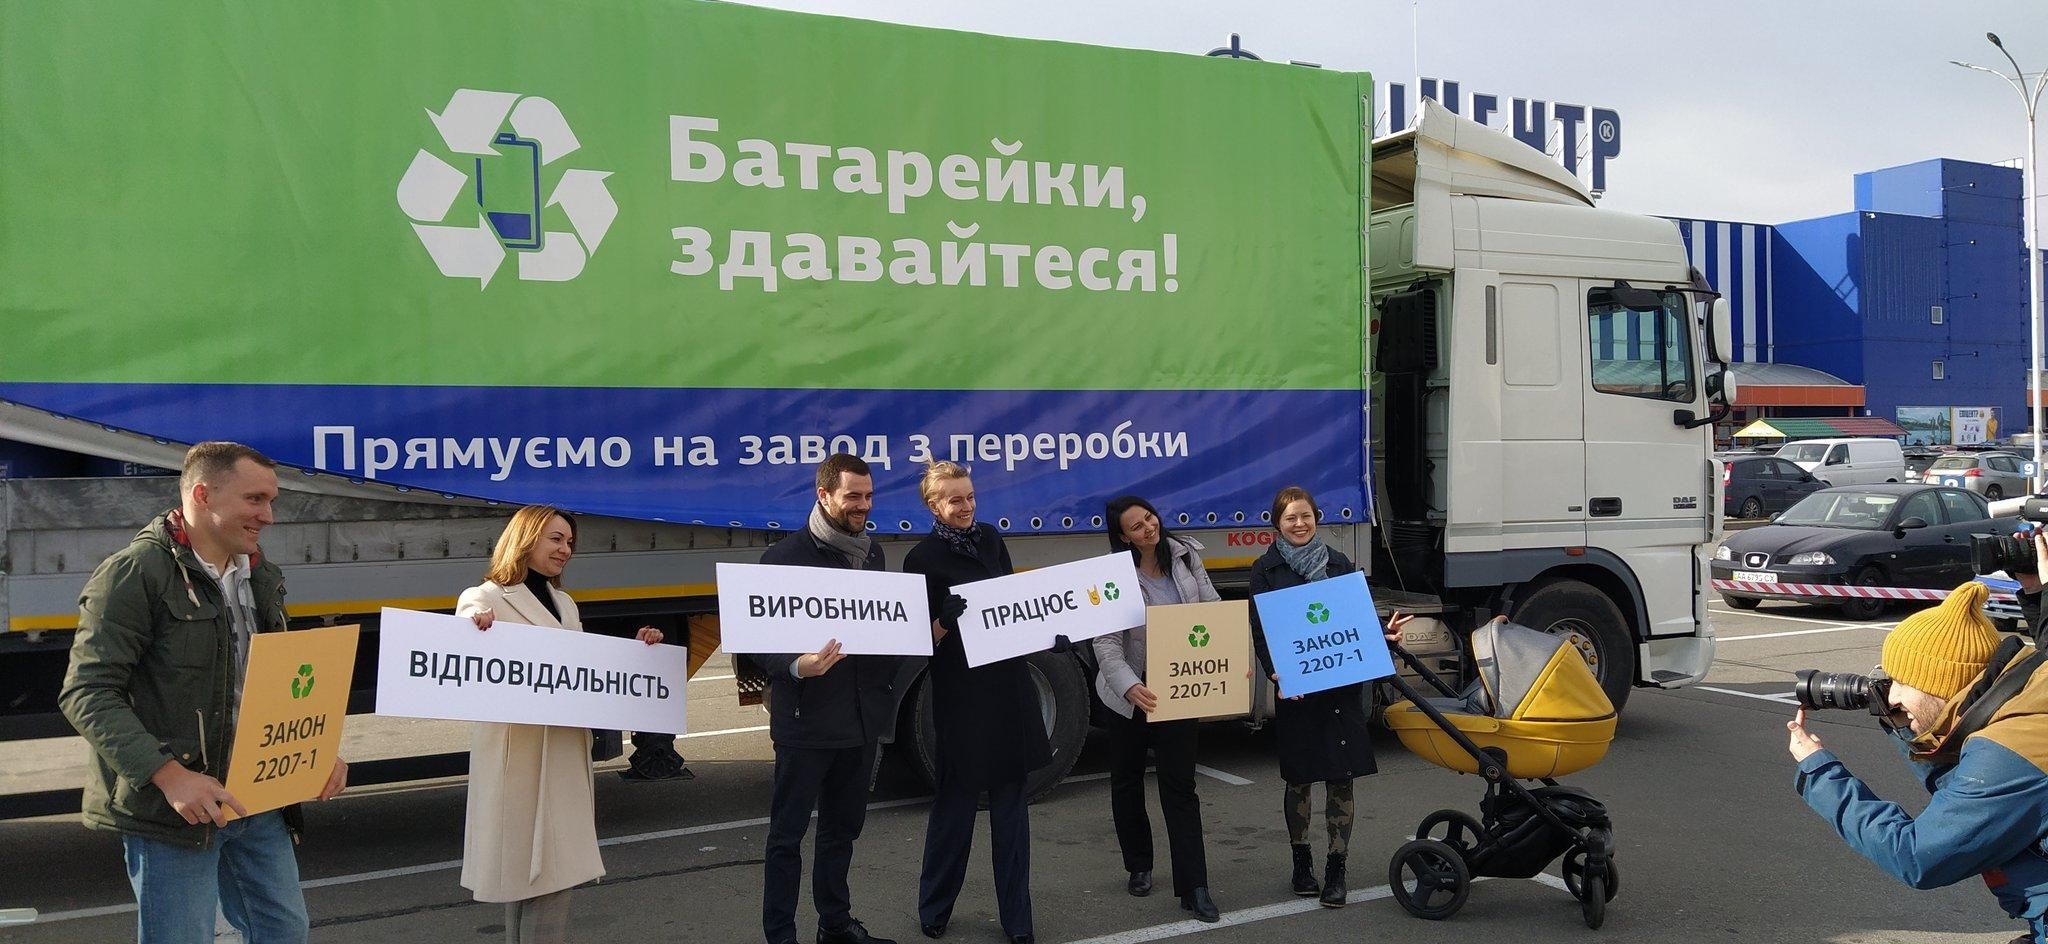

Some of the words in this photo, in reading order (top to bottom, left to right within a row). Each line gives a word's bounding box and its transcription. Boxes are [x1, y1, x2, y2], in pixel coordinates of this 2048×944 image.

[669, 115, 1147, 223] Батарейки,
[670, 219, 1179, 293] здавайтеся!
[313, 425, 632, 481] Прямуємо
[654, 435, 719, 466] на
[738, 434, 891, 471] завод
[908, 433, 931, 463] з
[950, 420, 1189, 471] переробки
[2023, 463, 2034, 475] 9
[748, 595, 908, 623] ВИРОБНИКА
[981, 590, 1079, 630] ПРАЦЮЄ
[1292, 627, 1361, 655] ЗАКОН
[1406, 632, 1438, 642] DAF
[409, 650, 670, 700] ВІДПОВІДАЛЬНІСТЬ
[1169, 658, 1229, 678] ЗАКОН
[1299, 648, 1363, 675] 2207-1
[1169, 683, 1227, 700] 2207-1
[260, 713, 327, 748] ЗАКОН
[253, 753, 317, 784] 2207-1
